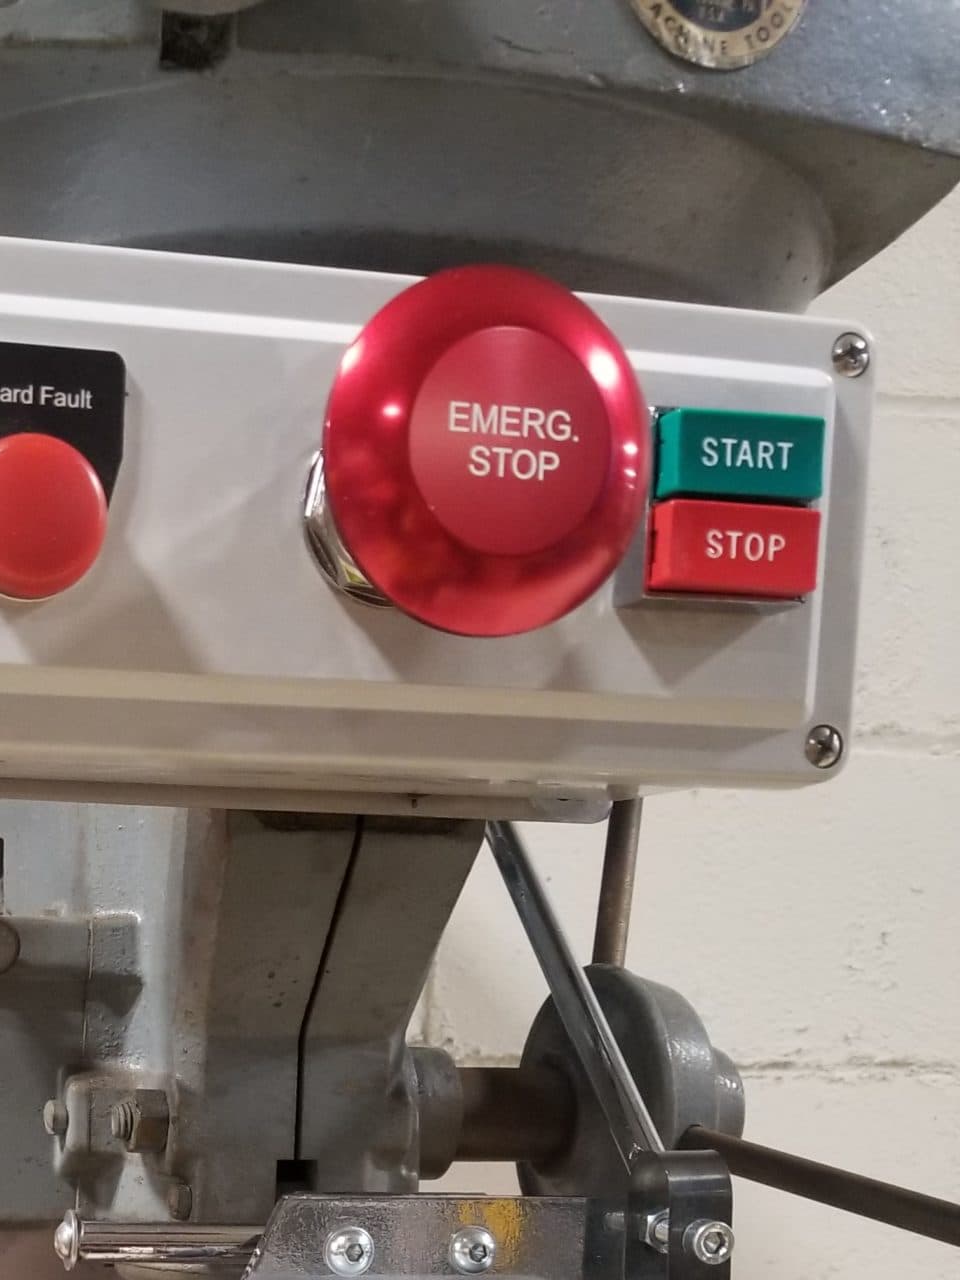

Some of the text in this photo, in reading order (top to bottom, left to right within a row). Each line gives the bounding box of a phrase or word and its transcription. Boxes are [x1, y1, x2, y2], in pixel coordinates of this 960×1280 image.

[39, 386, 93, 409] Fault
[447, 401, 580, 443] EMERG.
[468, 445, 561, 481] STOP
[700, 437, 794, 471] START
[705, 529, 786, 562] STOP
